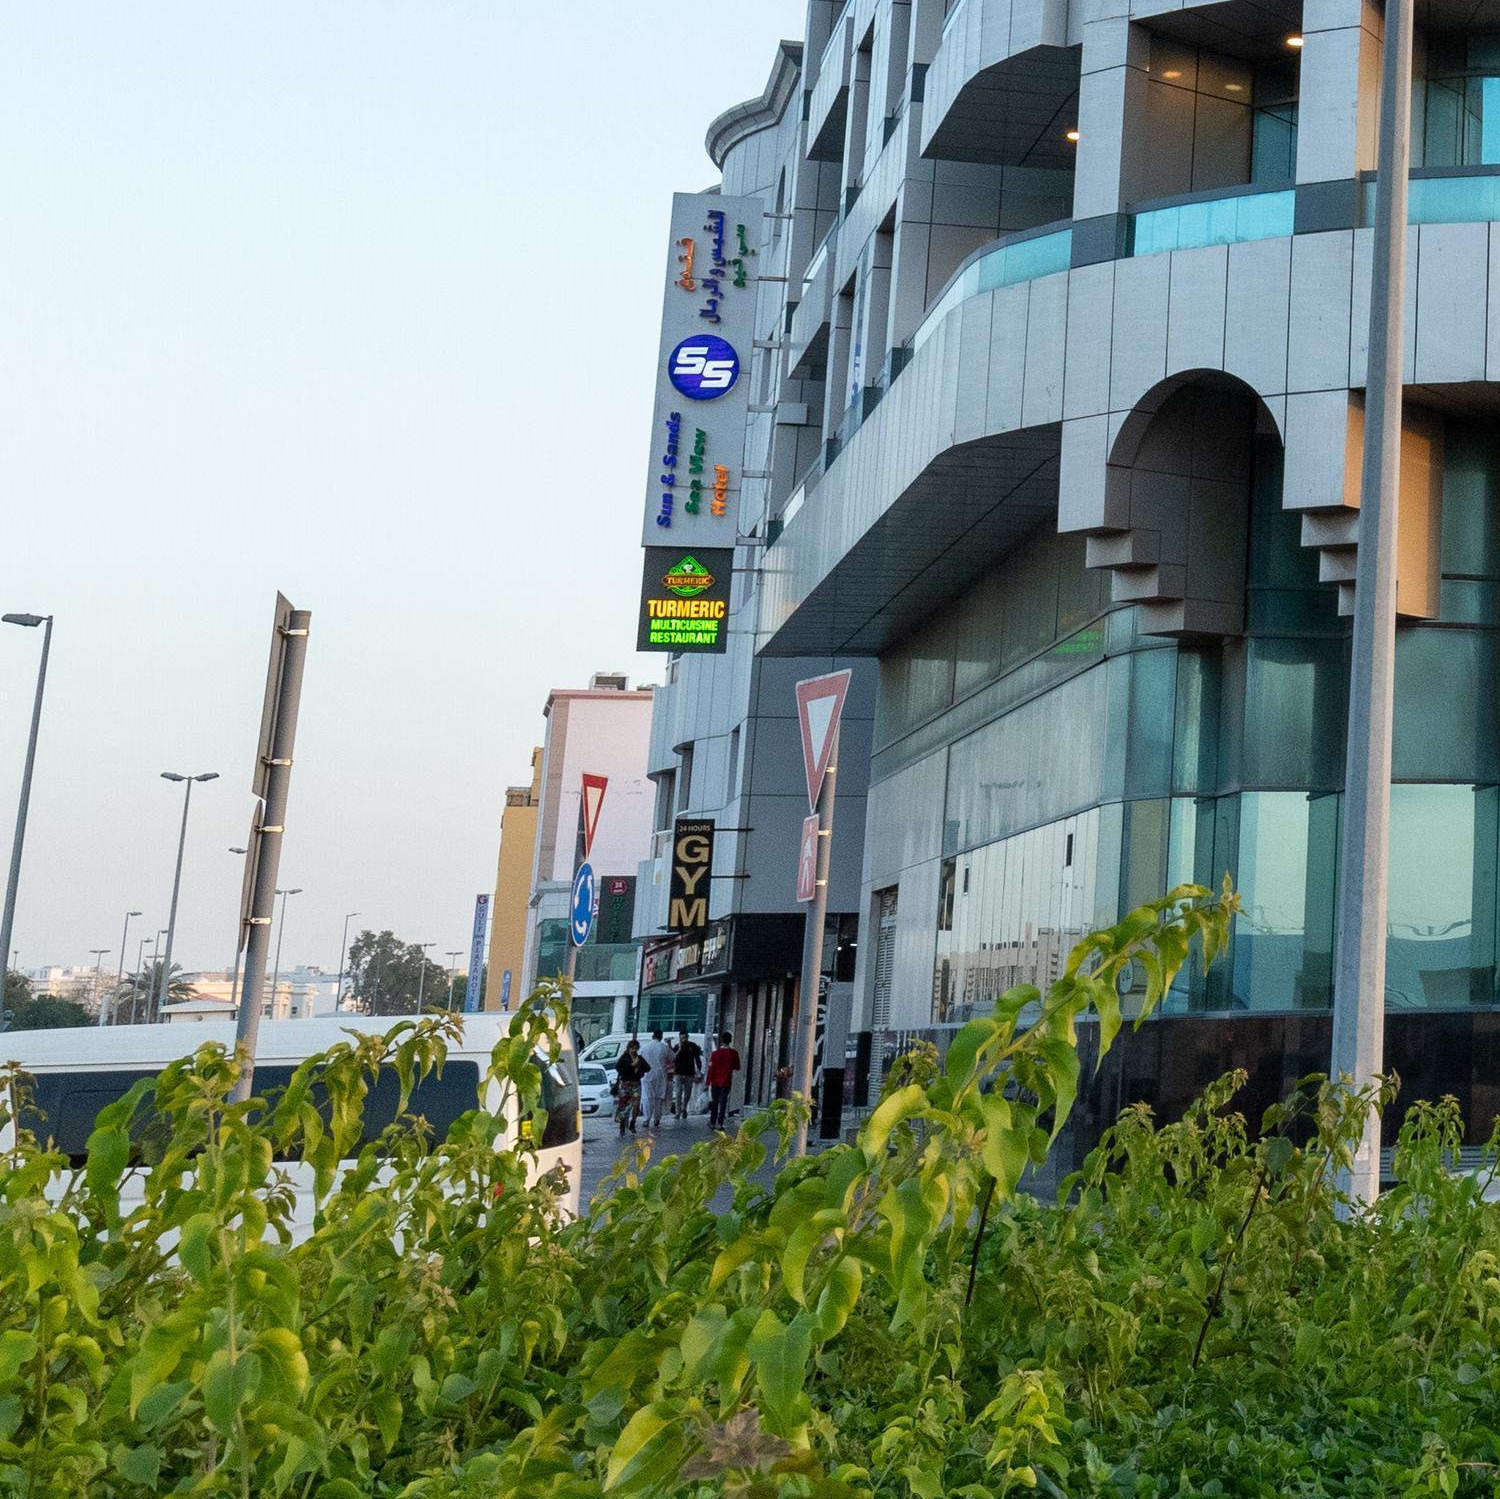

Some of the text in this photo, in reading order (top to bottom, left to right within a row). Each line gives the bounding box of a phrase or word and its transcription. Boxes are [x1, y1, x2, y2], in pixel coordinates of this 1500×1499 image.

[704, 210, 727, 267] الشمس
[674, 238, 696, 292] فندق
[674, 347, 734, 388] SS
[657, 411, 681, 528] Sun & Sands
[685, 428, 706, 515] Sea View
[710, 464, 729, 516] Hotel
[667, 577, 710, 585] TURMERIC
[647, 600, 725, 618] TURMERIC
[651, 619, 718, 631] MULTICUISINE
[649, 631, 717, 644] RESTAURANT
[670, 835, 710, 927] GYM
